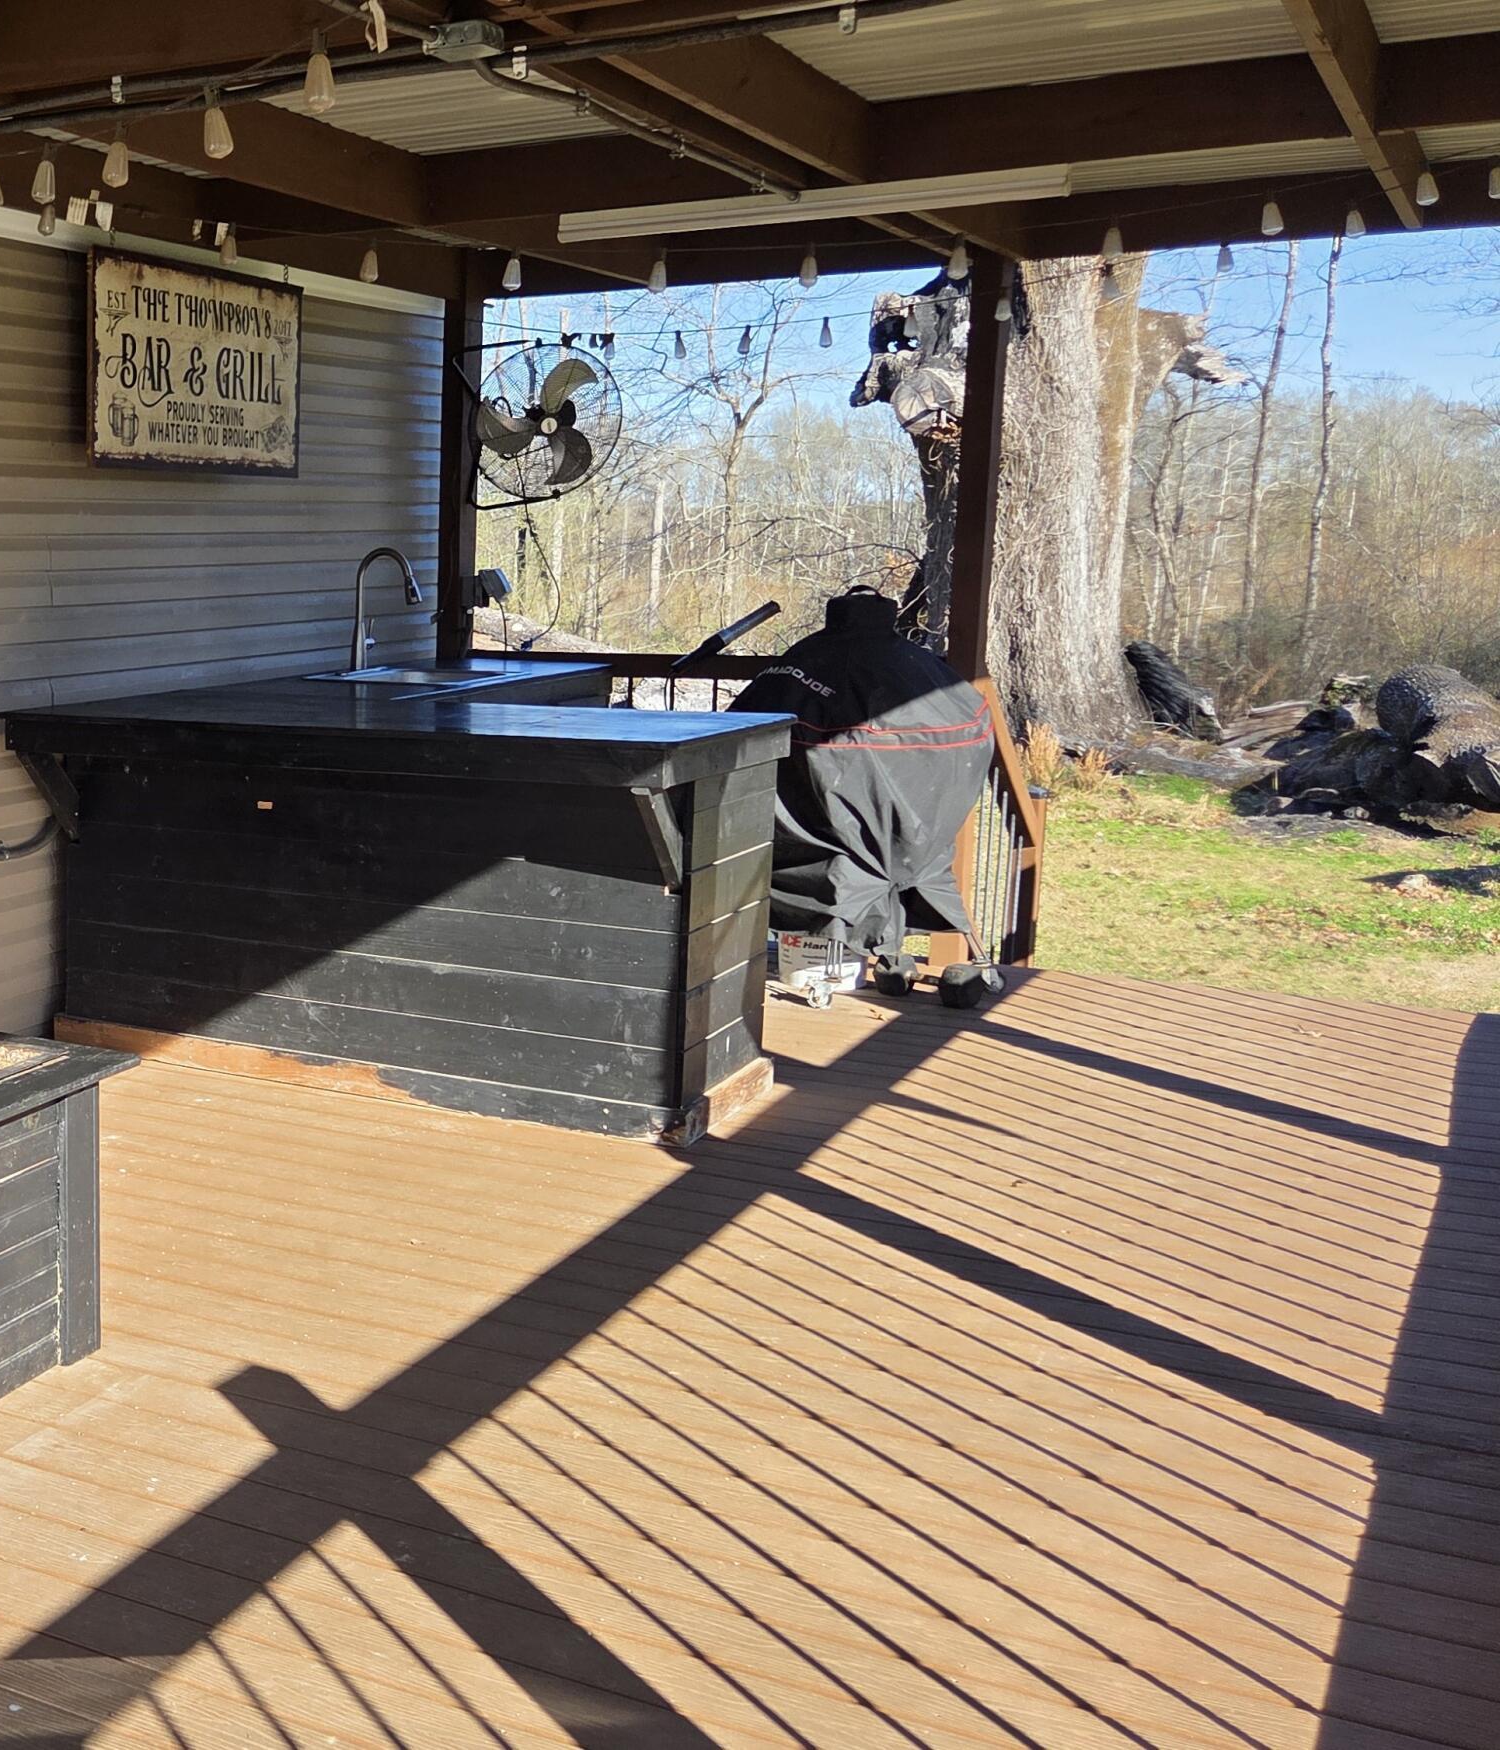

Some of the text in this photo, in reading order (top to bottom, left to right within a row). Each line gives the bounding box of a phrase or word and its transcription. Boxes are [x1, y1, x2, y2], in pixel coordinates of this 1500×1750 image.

[107, 290, 127, 310] EST
[131, 285, 272, 340] THE THOMPSON'S
[105, 333, 285, 408] BAR & GRILL
[166, 400, 245, 427] PROUDLY SERVING
[148, 421, 260, 449] WHATEVER YOU BROUGHT
